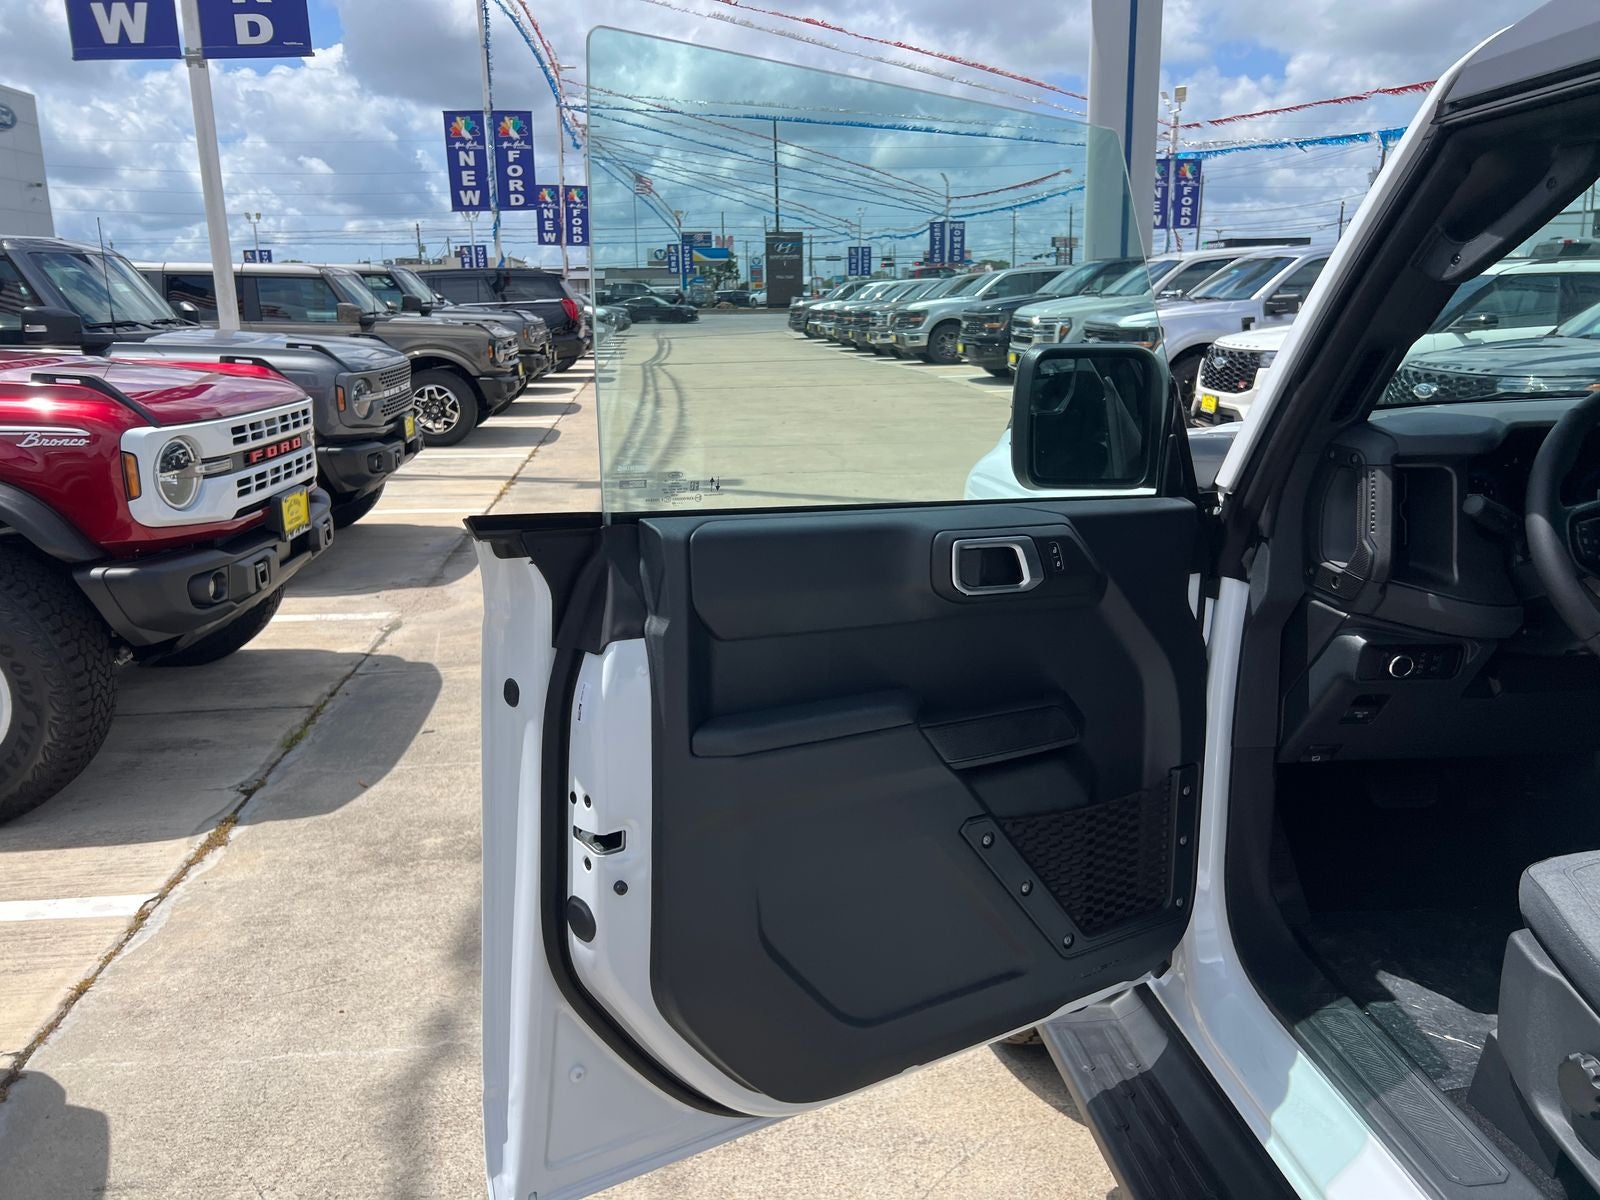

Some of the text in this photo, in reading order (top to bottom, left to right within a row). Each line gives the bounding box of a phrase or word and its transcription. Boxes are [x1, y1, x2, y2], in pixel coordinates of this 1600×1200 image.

[231, 0, 274, 45] D
[458, 151, 480, 206] NEW
[506, 150, 525, 206] FORD
[1180, 186, 1193, 226] FORD
[542, 208, 556, 243] NEW
[572, 209, 583, 243] FORD
[16, 431, 90, 448] Bronco
[250, 437, 302, 464] FORD
